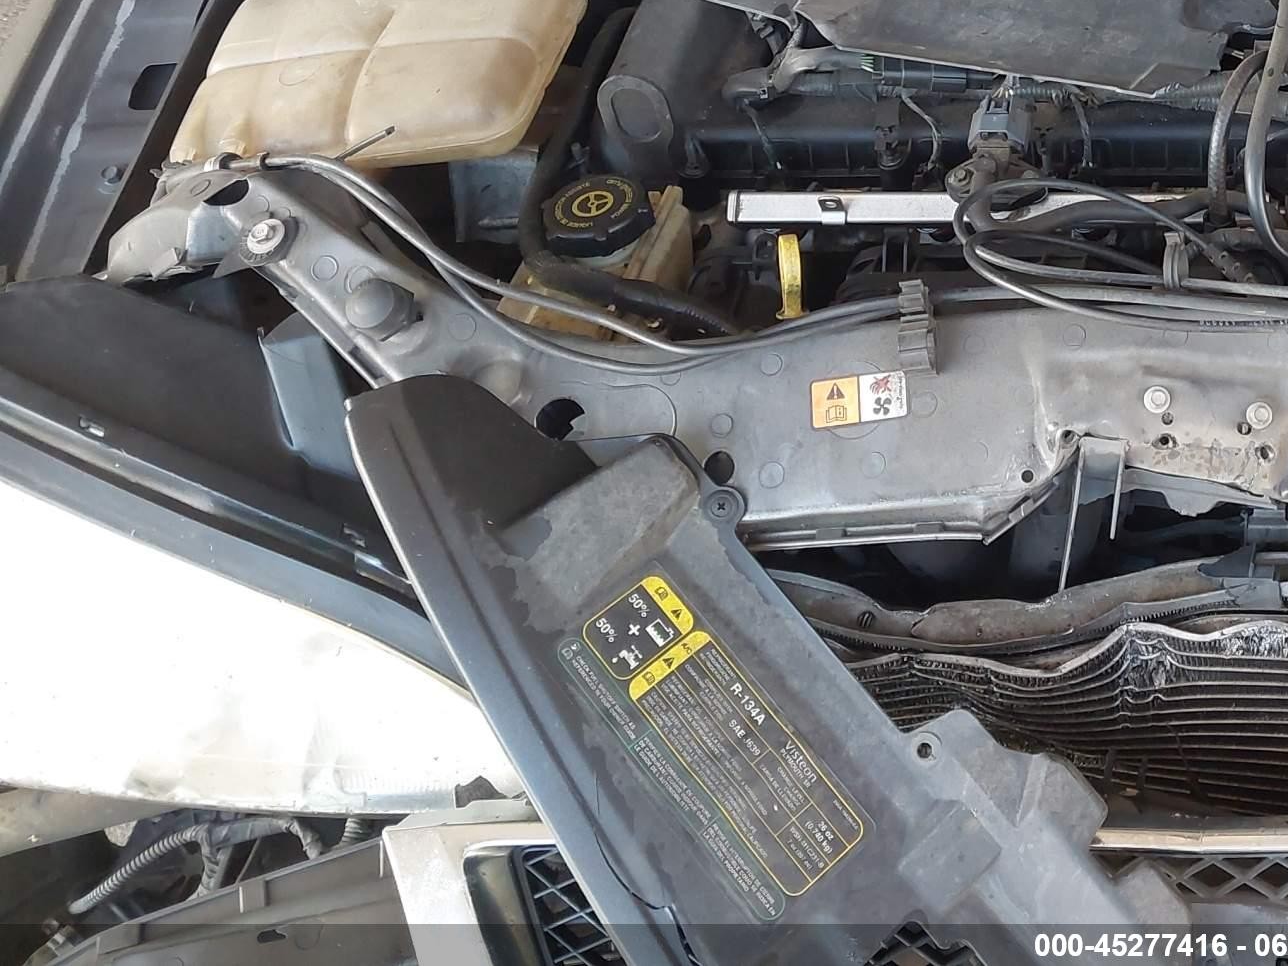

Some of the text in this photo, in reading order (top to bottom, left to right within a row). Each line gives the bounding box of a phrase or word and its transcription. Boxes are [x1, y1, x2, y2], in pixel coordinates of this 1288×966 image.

[626, 591, 652, 619] 50%
[593, 616, 620, 644] 50%
[728, 681, 768, 726] R-134A
[636, 739, 647, 749] DE
[726, 717, 762, 757] SAE J639
[631, 743, 642, 753] LE
[648, 764, 659, 774] DE
[776, 746, 806, 780] PLYMOUTH
[780, 738, 821, 784] Visteon
[701, 831, 711, 840] LA
[802, 819, 835, 855] (0.740 kg)
[815, 819, 836, 842] 26 oz
